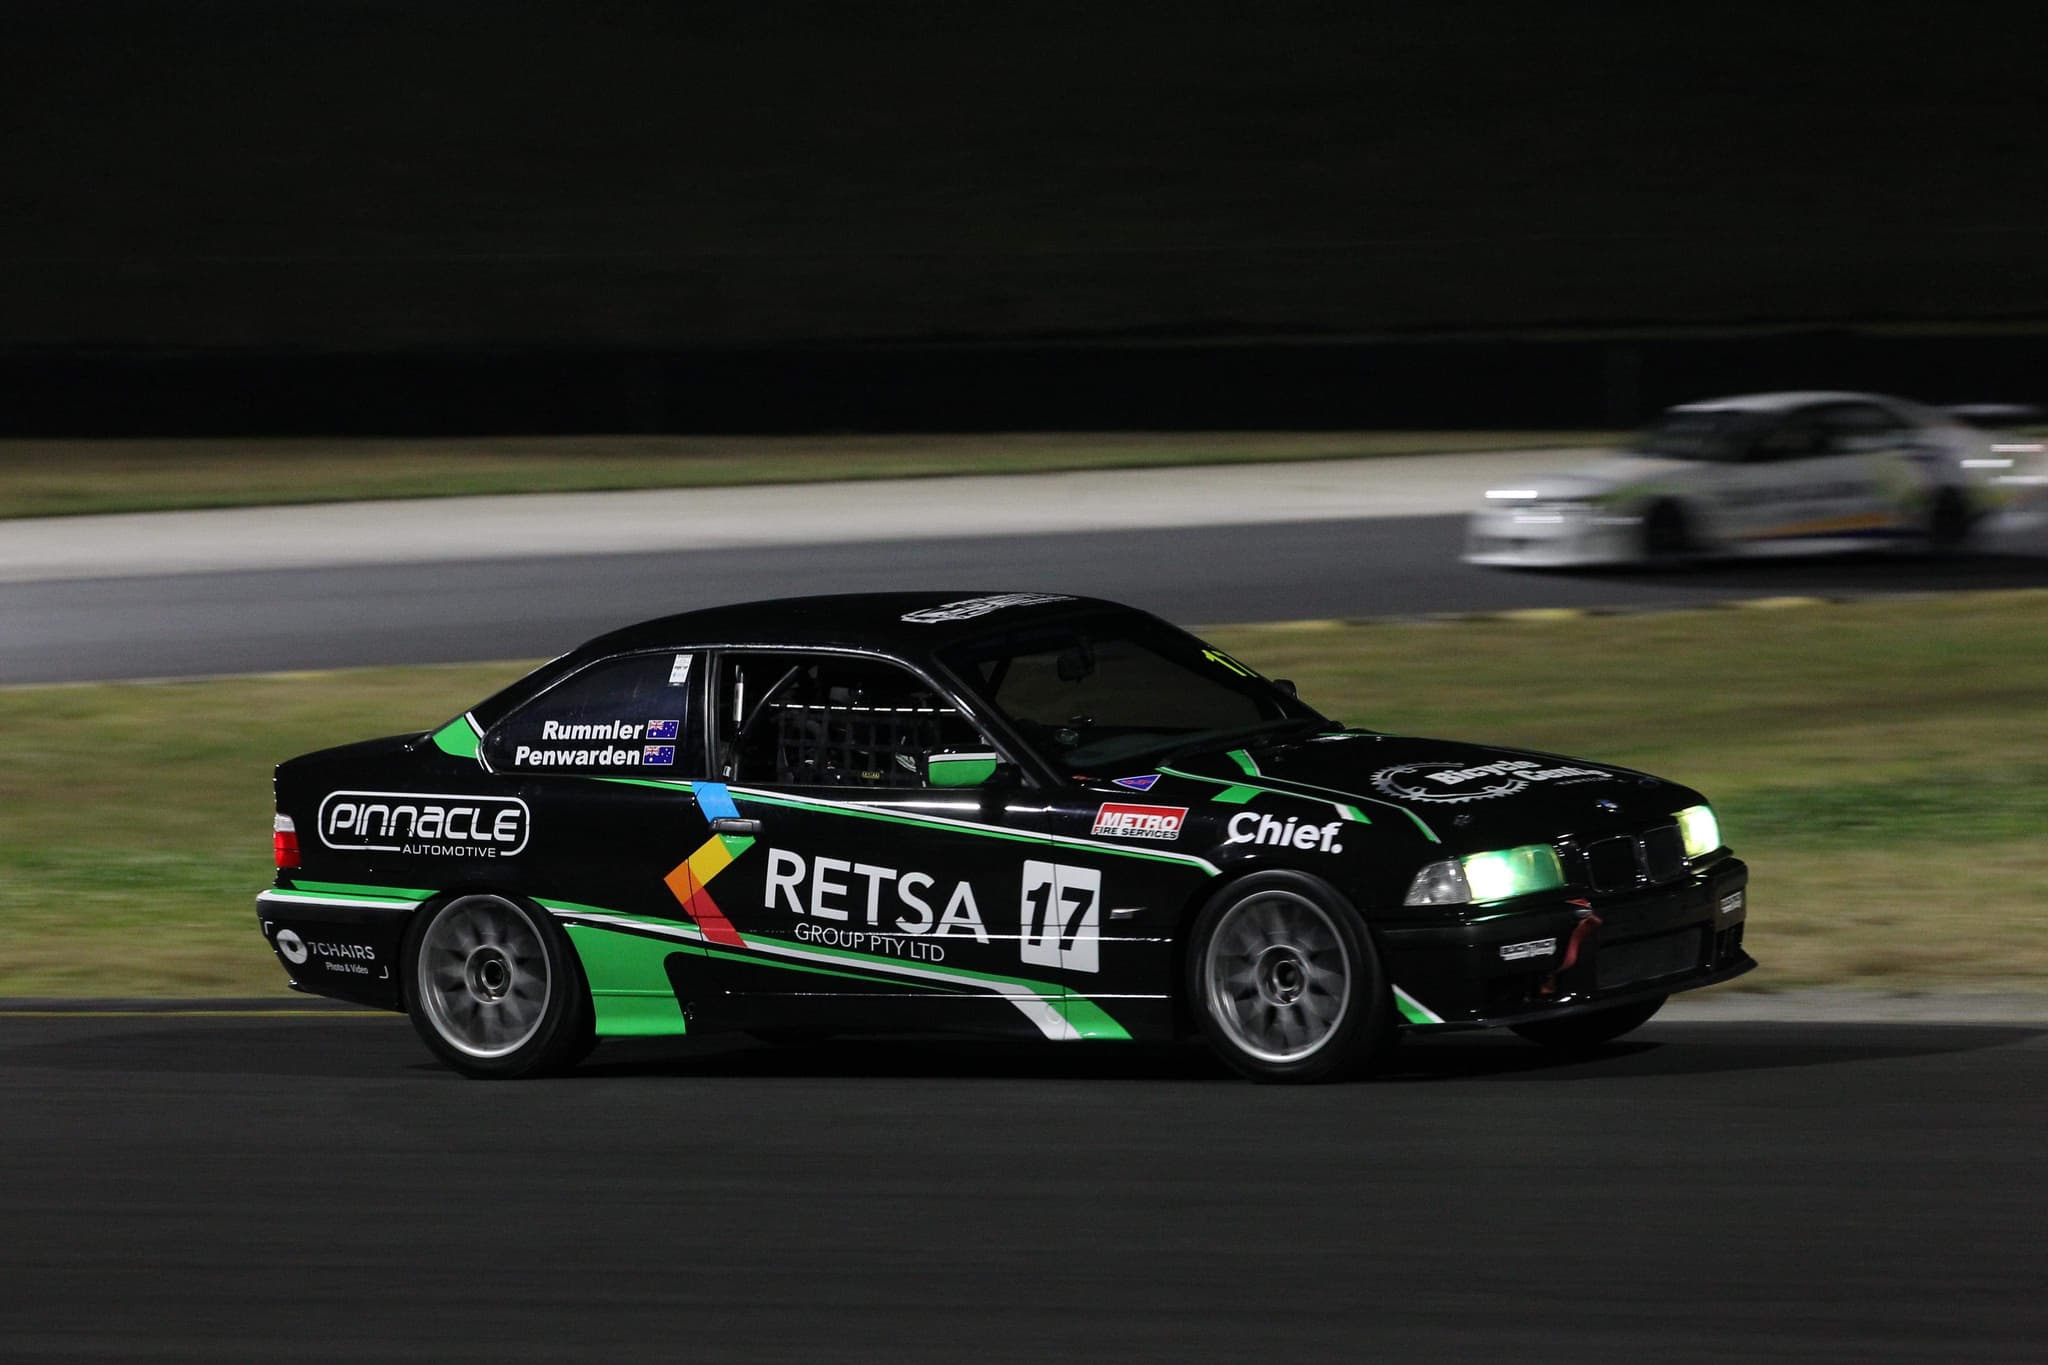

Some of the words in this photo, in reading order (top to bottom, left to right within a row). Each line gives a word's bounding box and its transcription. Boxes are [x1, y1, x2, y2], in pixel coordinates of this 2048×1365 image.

[542, 720, 644, 740] Rummler
[514, 745, 640, 766] Penwarden
[329, 803, 521, 842] PINNACLE
[1101, 812, 1179, 830] METRO
[1093, 826, 1118, 835] FIRE
[1121, 828, 1178, 839] SERVICES
[1222, 811, 1344, 854] Chief.
[402, 844, 496, 858] AUTOMOTIVE
[764, 847, 990, 944] RETSA
[1026, 882, 1095, 951] 17
[307, 941, 376, 960] 7CHAIRS
[794, 922, 865, 949] GROUP
[870, 935, 905, 956] PTY
[910, 941, 945, 962] LTD
